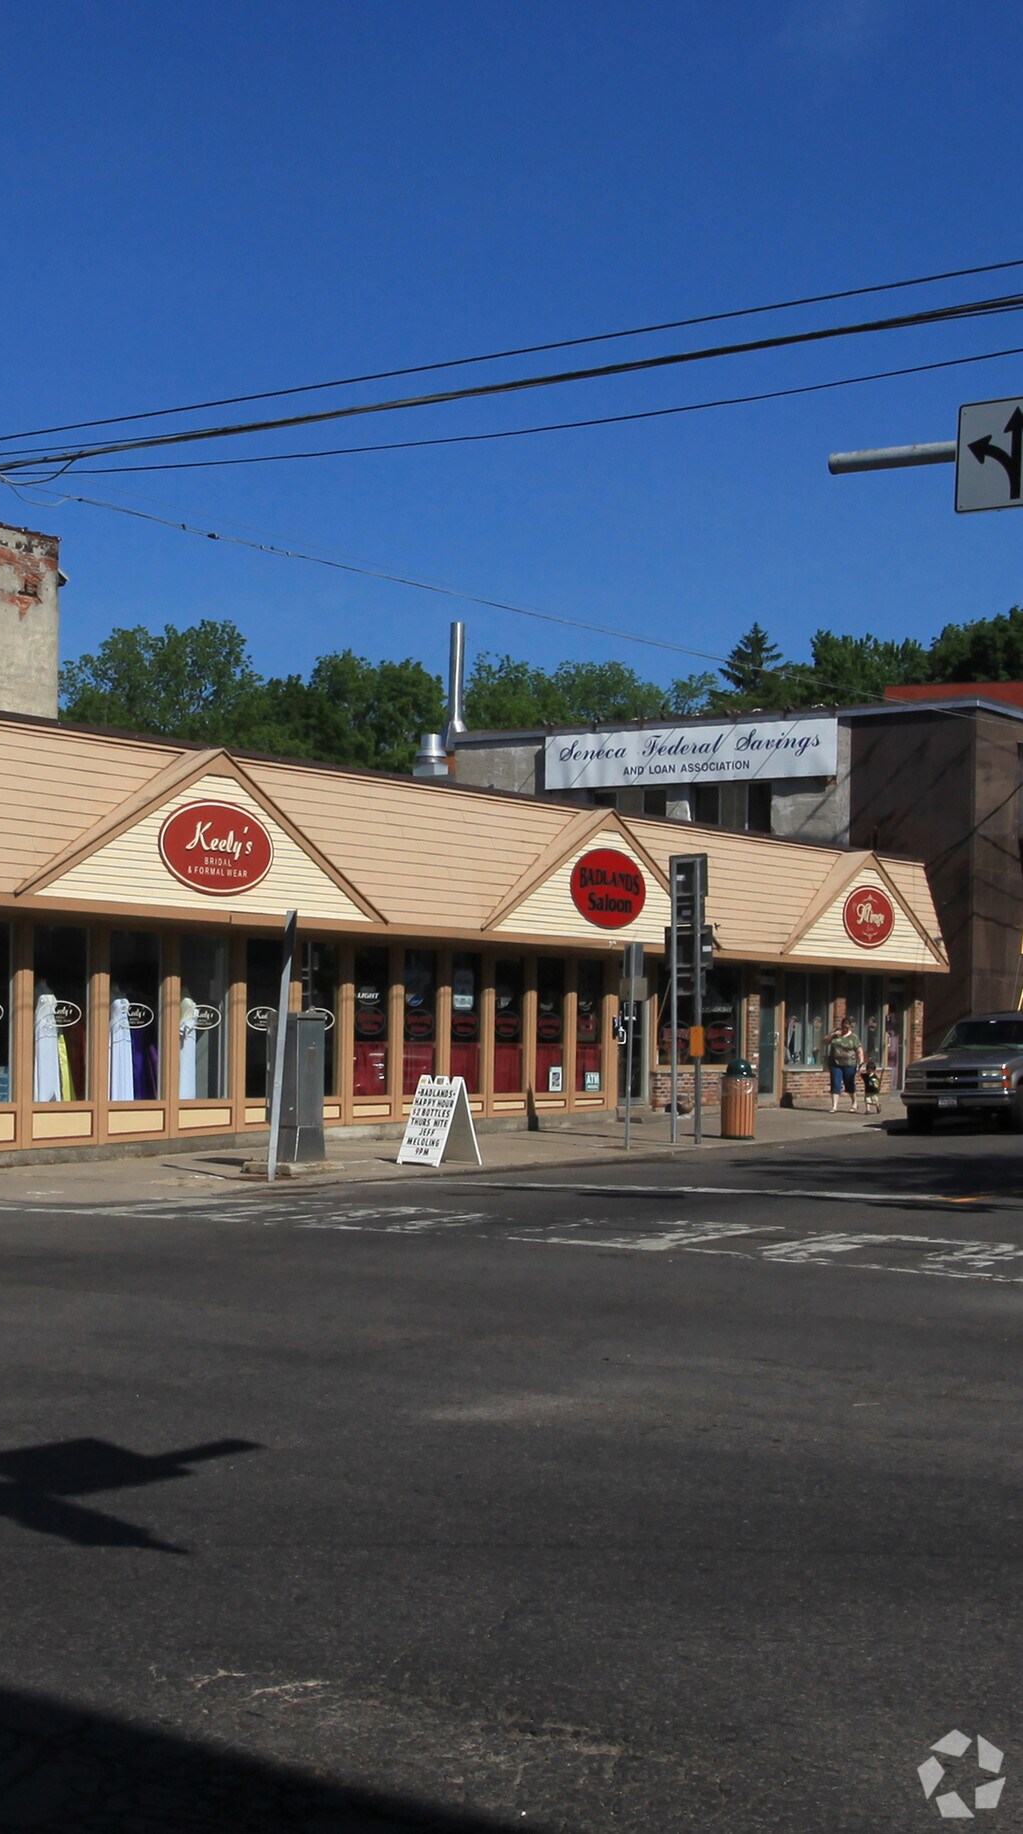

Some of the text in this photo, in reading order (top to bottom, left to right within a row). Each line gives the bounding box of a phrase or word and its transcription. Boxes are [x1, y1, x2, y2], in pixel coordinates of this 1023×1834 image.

[559, 728, 822, 762] Seneca Federal Savings
[623, 760, 751, 776] AND LOAN ASSOCIATION
[185, 821, 253, 861] Keely's
[204, 857, 232, 867] BRIDAL
[194, 866, 225, 877] FORMAL
[226, 869, 249, 878] WEAR
[579, 866, 641, 897] BADLANDS
[587, 892, 633, 913] Saloon
[421, 1109, 451, 1118] BOTTLES
[411, 1117, 431, 1126] THURS
[419, 1128, 436, 1137] JEFF
